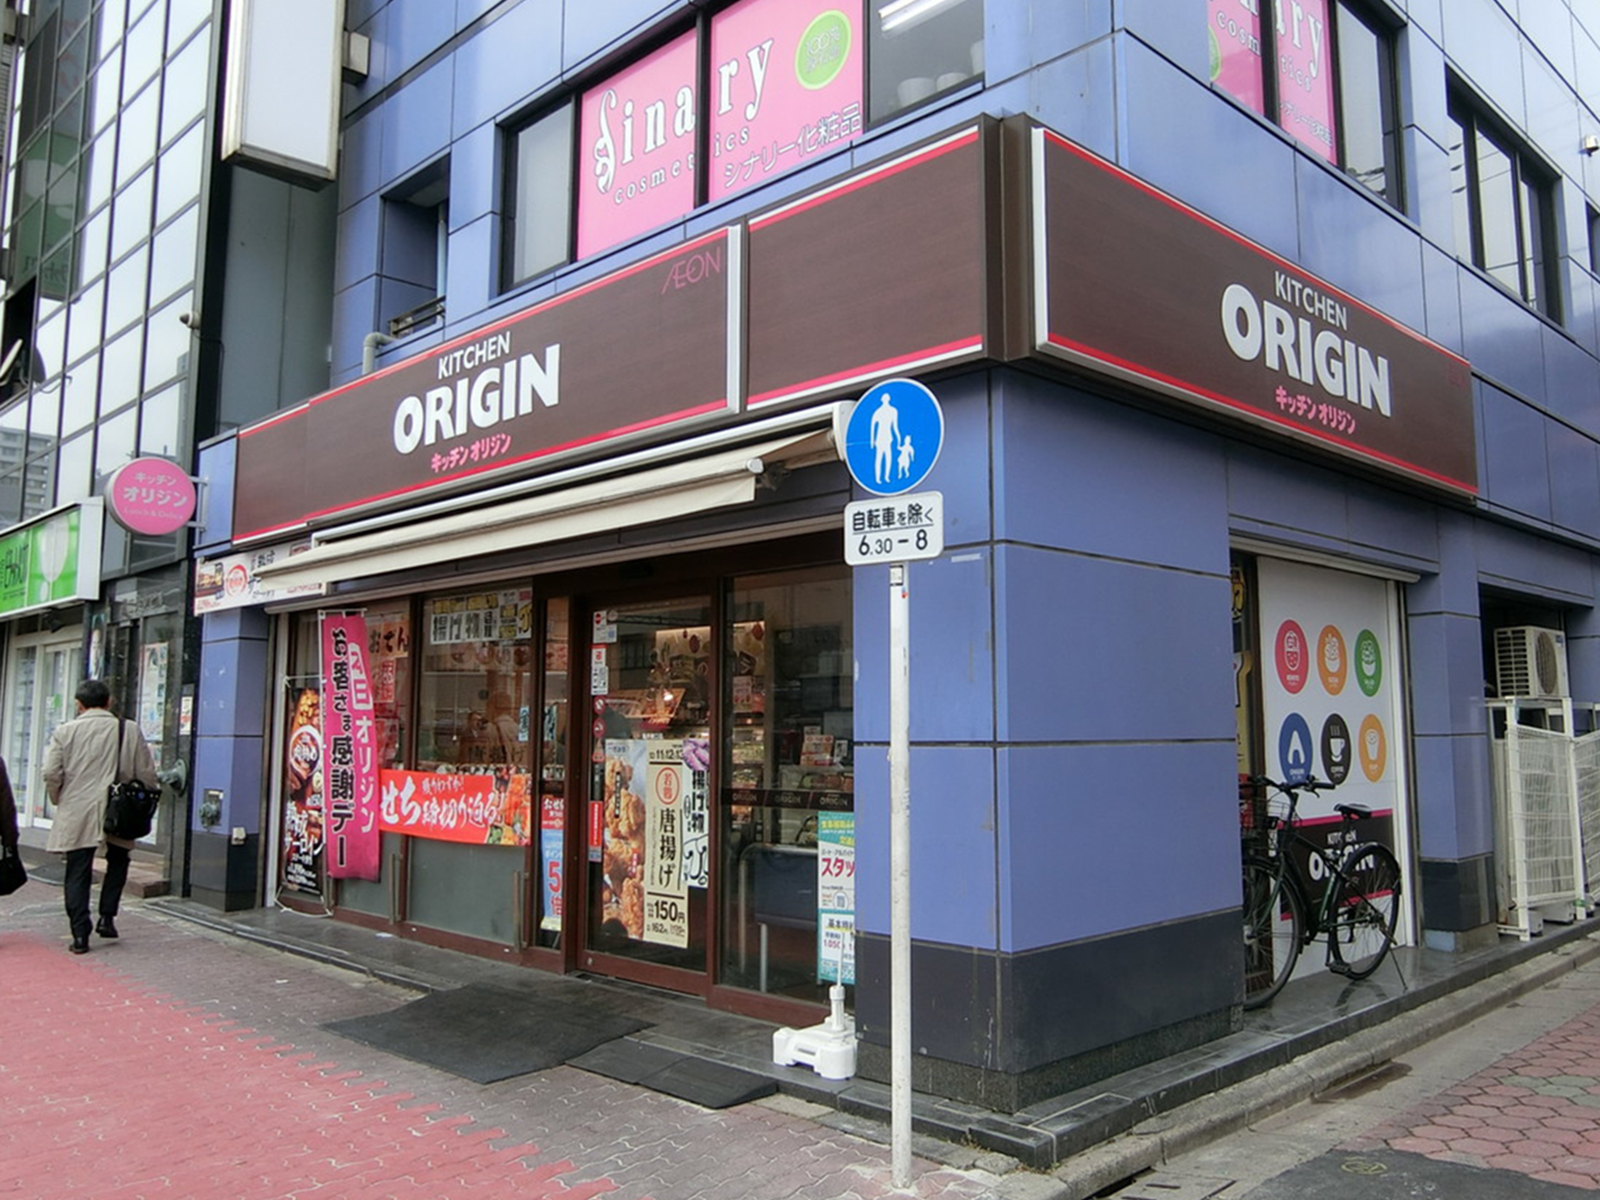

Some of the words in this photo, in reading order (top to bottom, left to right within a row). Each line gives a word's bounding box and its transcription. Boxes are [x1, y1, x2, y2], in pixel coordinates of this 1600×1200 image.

[1216, 10, 1312, 92] cosmtics
[723, 101, 863, 189] シナリー化粧品
[1274, 270, 1348, 331] KITCHEN
[437, 330, 511, 380] KITCHEN
[1221, 283, 1392, 418] ORIGIN
[393, 343, 560, 454] ORIGIN
[122, 486, 188, 508] オリジン
[135, 471, 177, 486] キッチン
[853, 503, 934, 532] 自転車を除く
[659, 808, 676, 888] 唐揚げ
